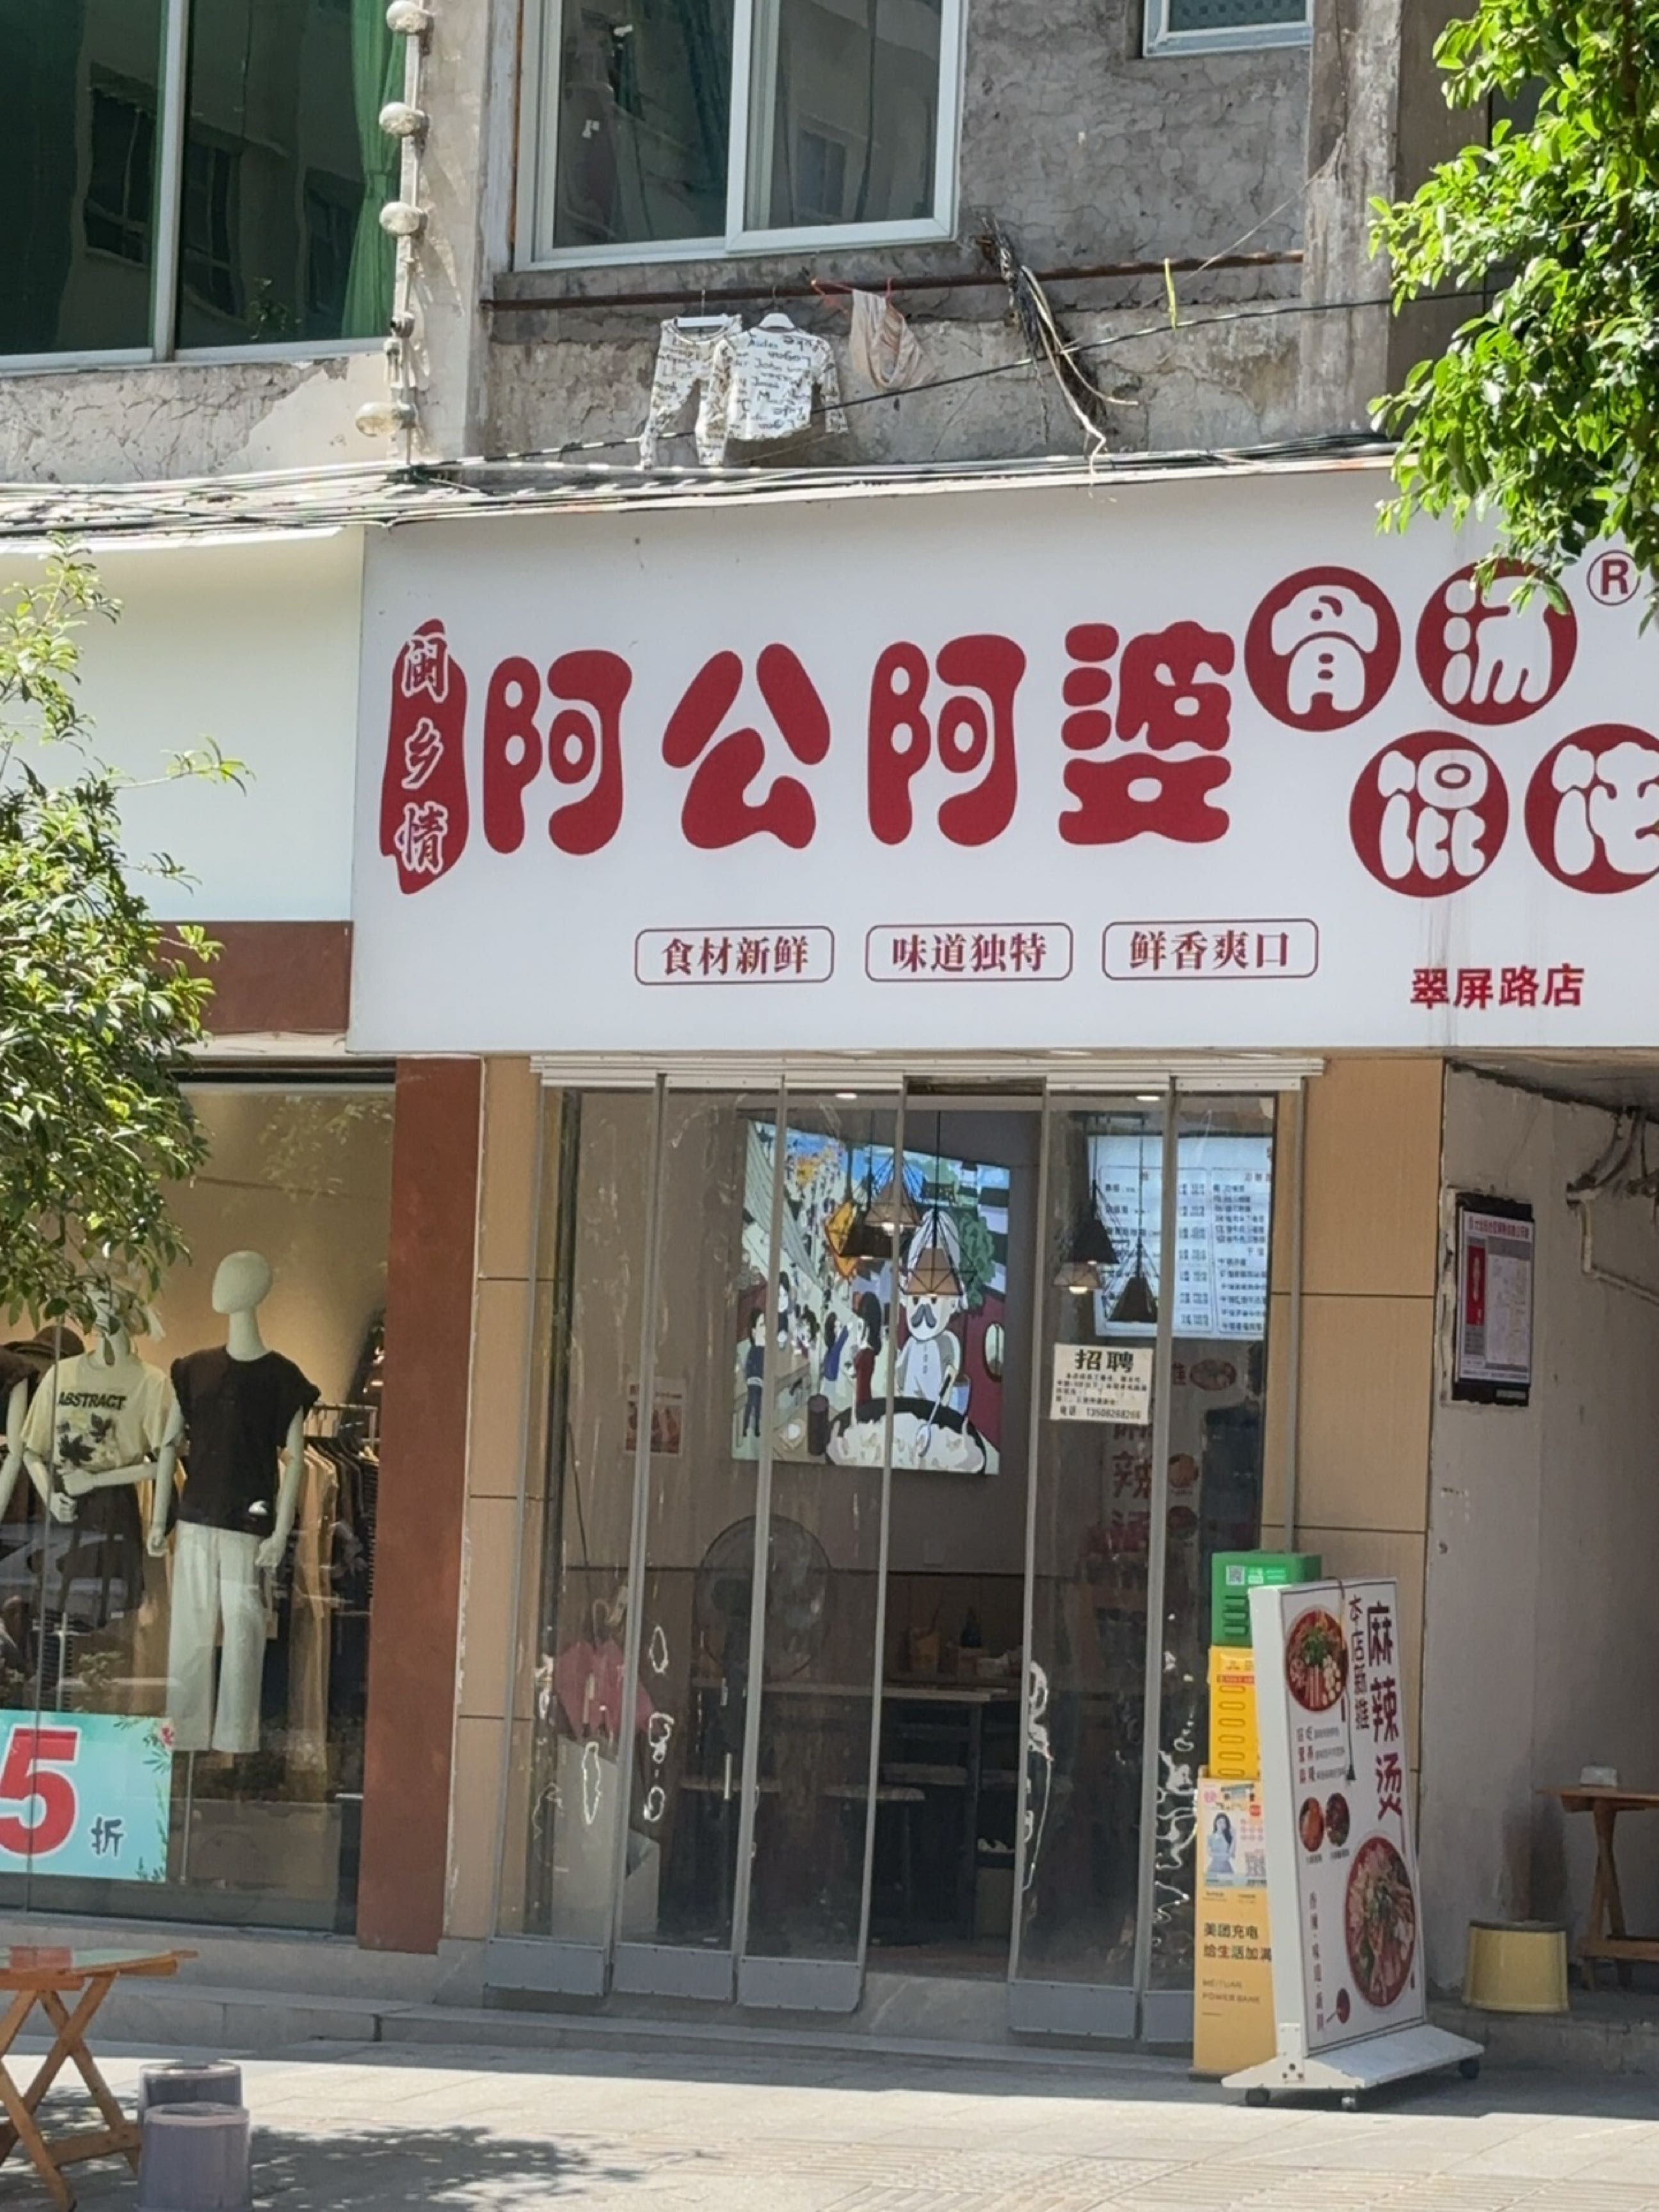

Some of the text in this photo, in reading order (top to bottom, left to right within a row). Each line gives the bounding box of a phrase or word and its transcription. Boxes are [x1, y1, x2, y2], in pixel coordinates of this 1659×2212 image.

[483, 620, 1235, 856] 阿公阿婆
[662, 937, 809, 975] 食材新鲜
[892, 934, 1047, 974] 味道独特
[1129, 931, 1289, 971] 鲜香爽口
[1410, 964, 1585, 1010] 翠屏路店
[1074, 1349, 1134, 1373] 招聘
[58, 1391, 128, 1411] ABSTRACT
[1367, 1599, 1403, 1821] 麻辣烫
[1203, 1922, 1259, 1940] 美团充电
